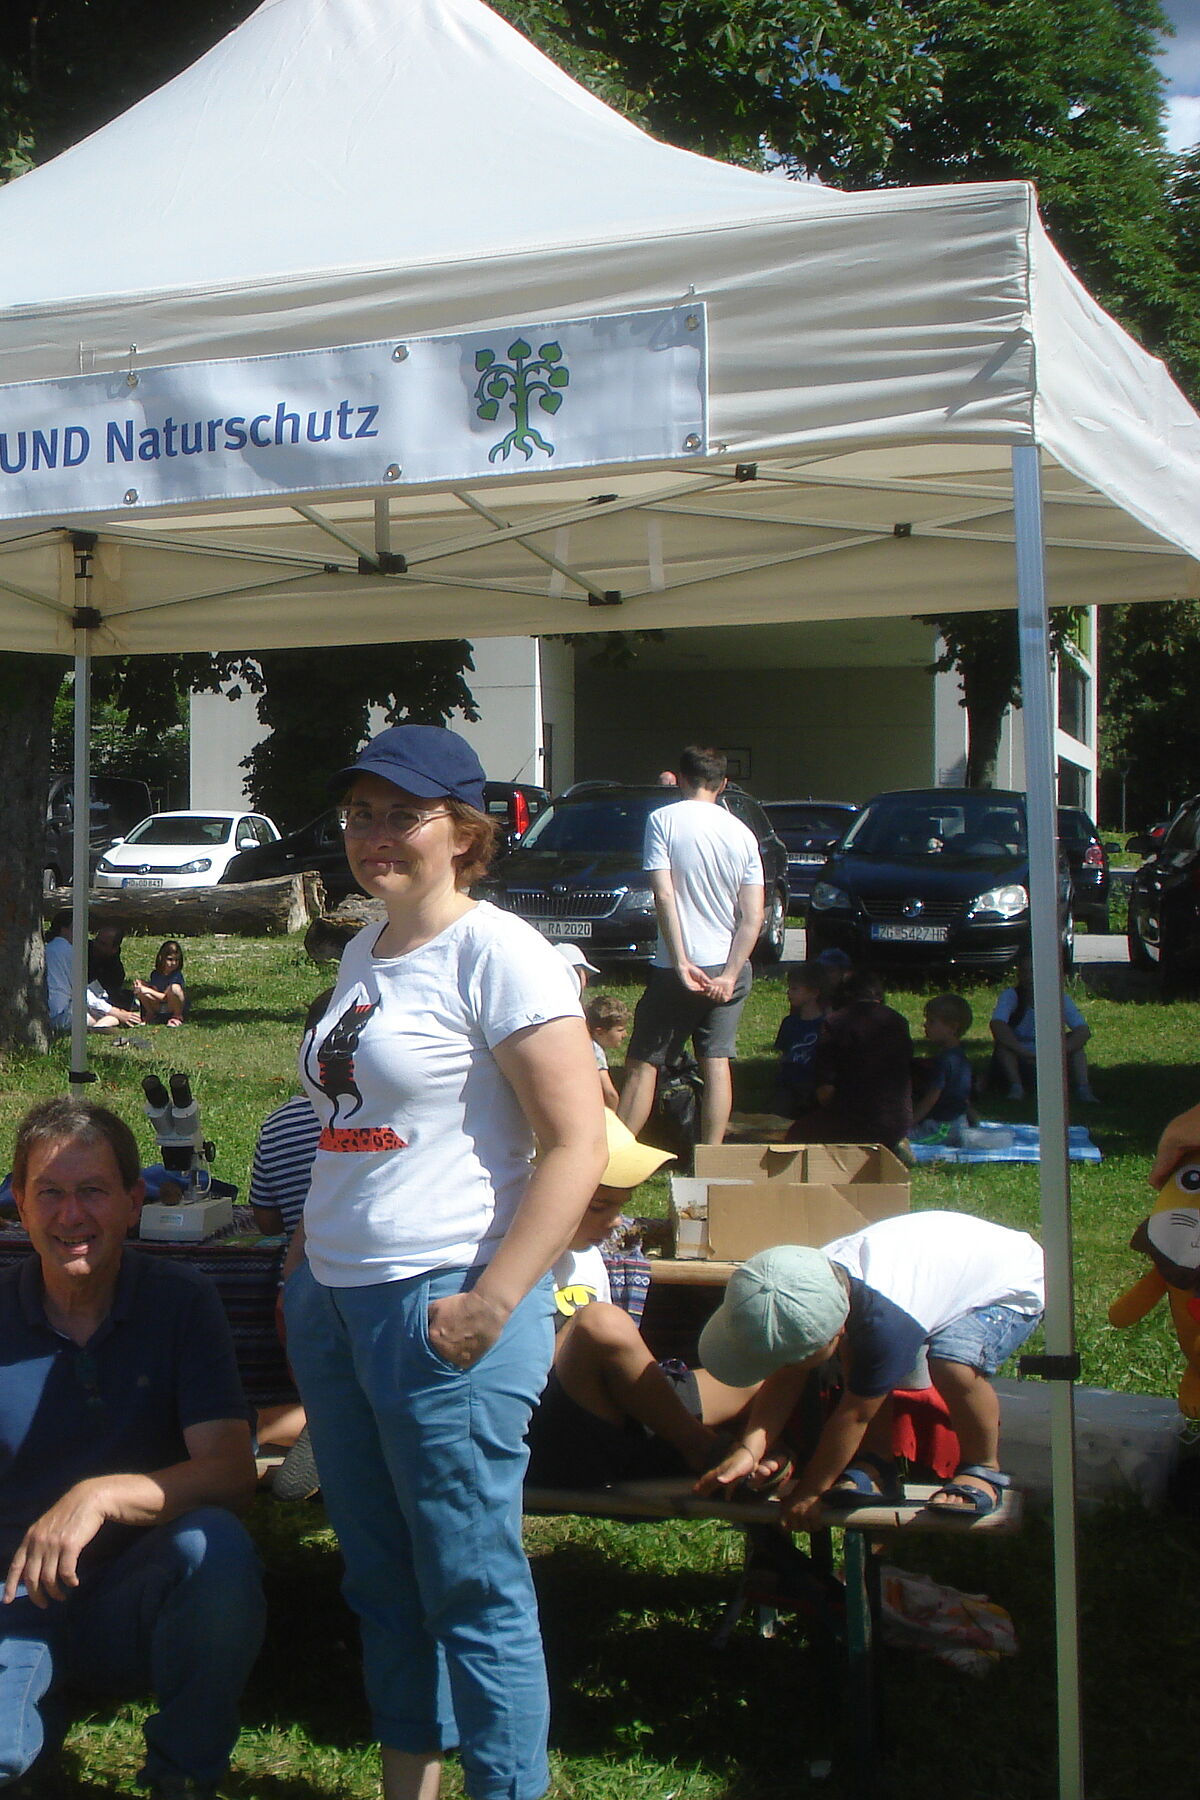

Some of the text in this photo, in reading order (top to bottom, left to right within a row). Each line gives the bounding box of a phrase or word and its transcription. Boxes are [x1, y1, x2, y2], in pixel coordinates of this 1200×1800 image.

[106, 400, 380, 463] Naturschutz
[548, 922, 561, 935] RA
[564, 923, 591, 936] 2020
